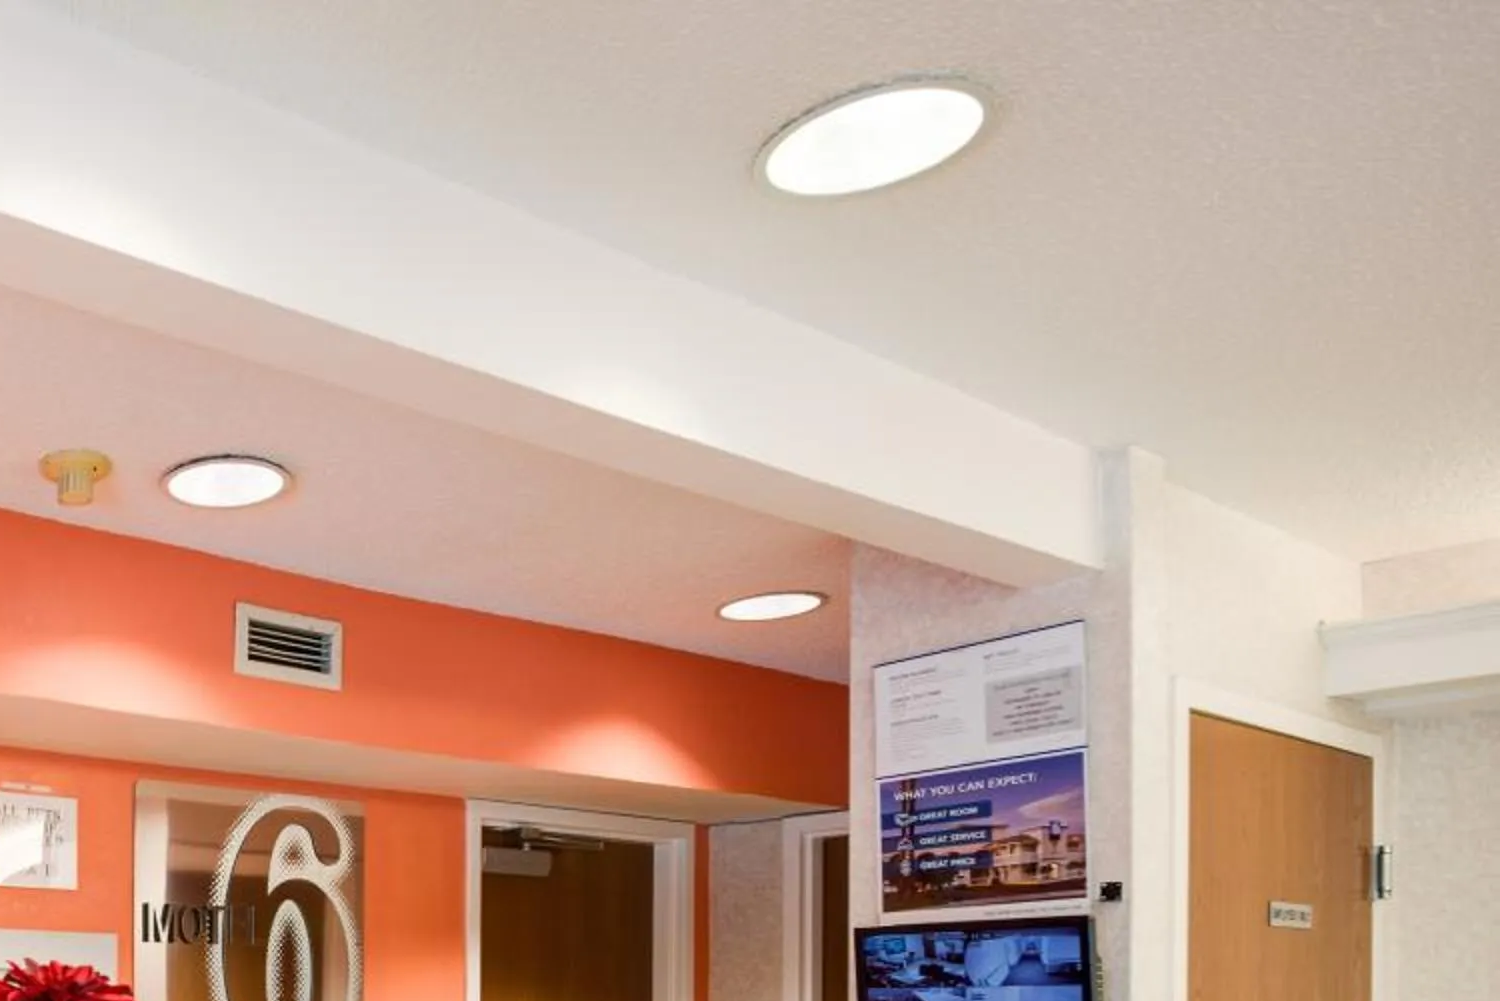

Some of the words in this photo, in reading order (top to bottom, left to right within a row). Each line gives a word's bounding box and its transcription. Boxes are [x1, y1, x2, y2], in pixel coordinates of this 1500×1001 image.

[894, 788, 926, 801] WHAT
[930, 784, 954, 797] YOU
[957, 780, 985, 793] CAN
[919, 810, 947, 821] GREAT
[950, 806, 978, 817] ROOM
[920, 835, 947, 846] GREAT
[950, 831, 986, 842] SERVICE
[920, 858, 948, 870] GREAT
[951, 857, 976, 867] PRICE
[141, 902, 257, 944] MOT
